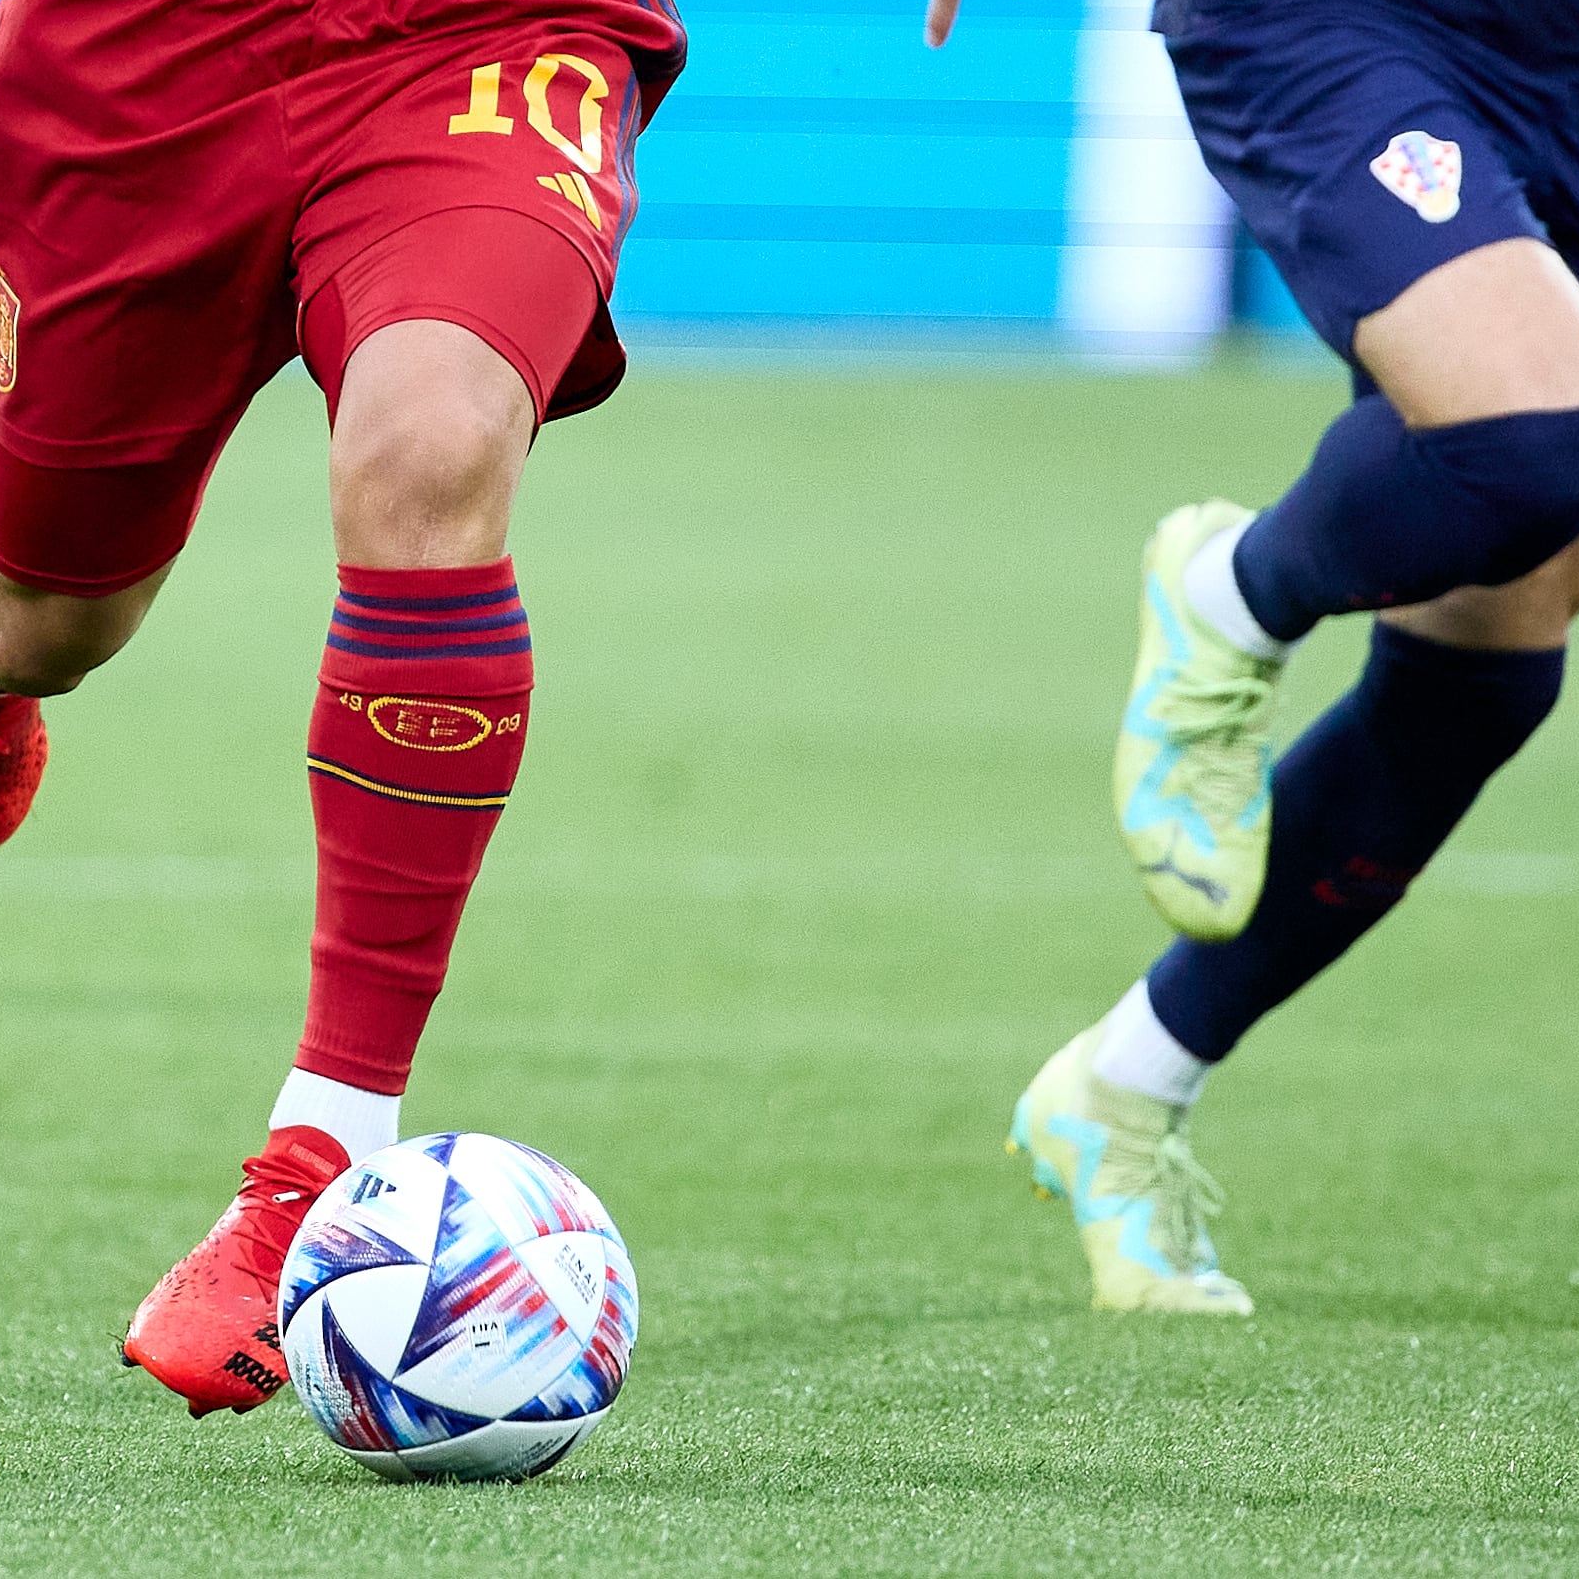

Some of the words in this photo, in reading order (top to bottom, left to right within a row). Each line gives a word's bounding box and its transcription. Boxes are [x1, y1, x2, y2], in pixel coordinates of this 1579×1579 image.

[448, 53, 610, 174] 10
[562, 1244, 597, 1295] FINAL
[471, 1322, 498, 1334] FIFA
